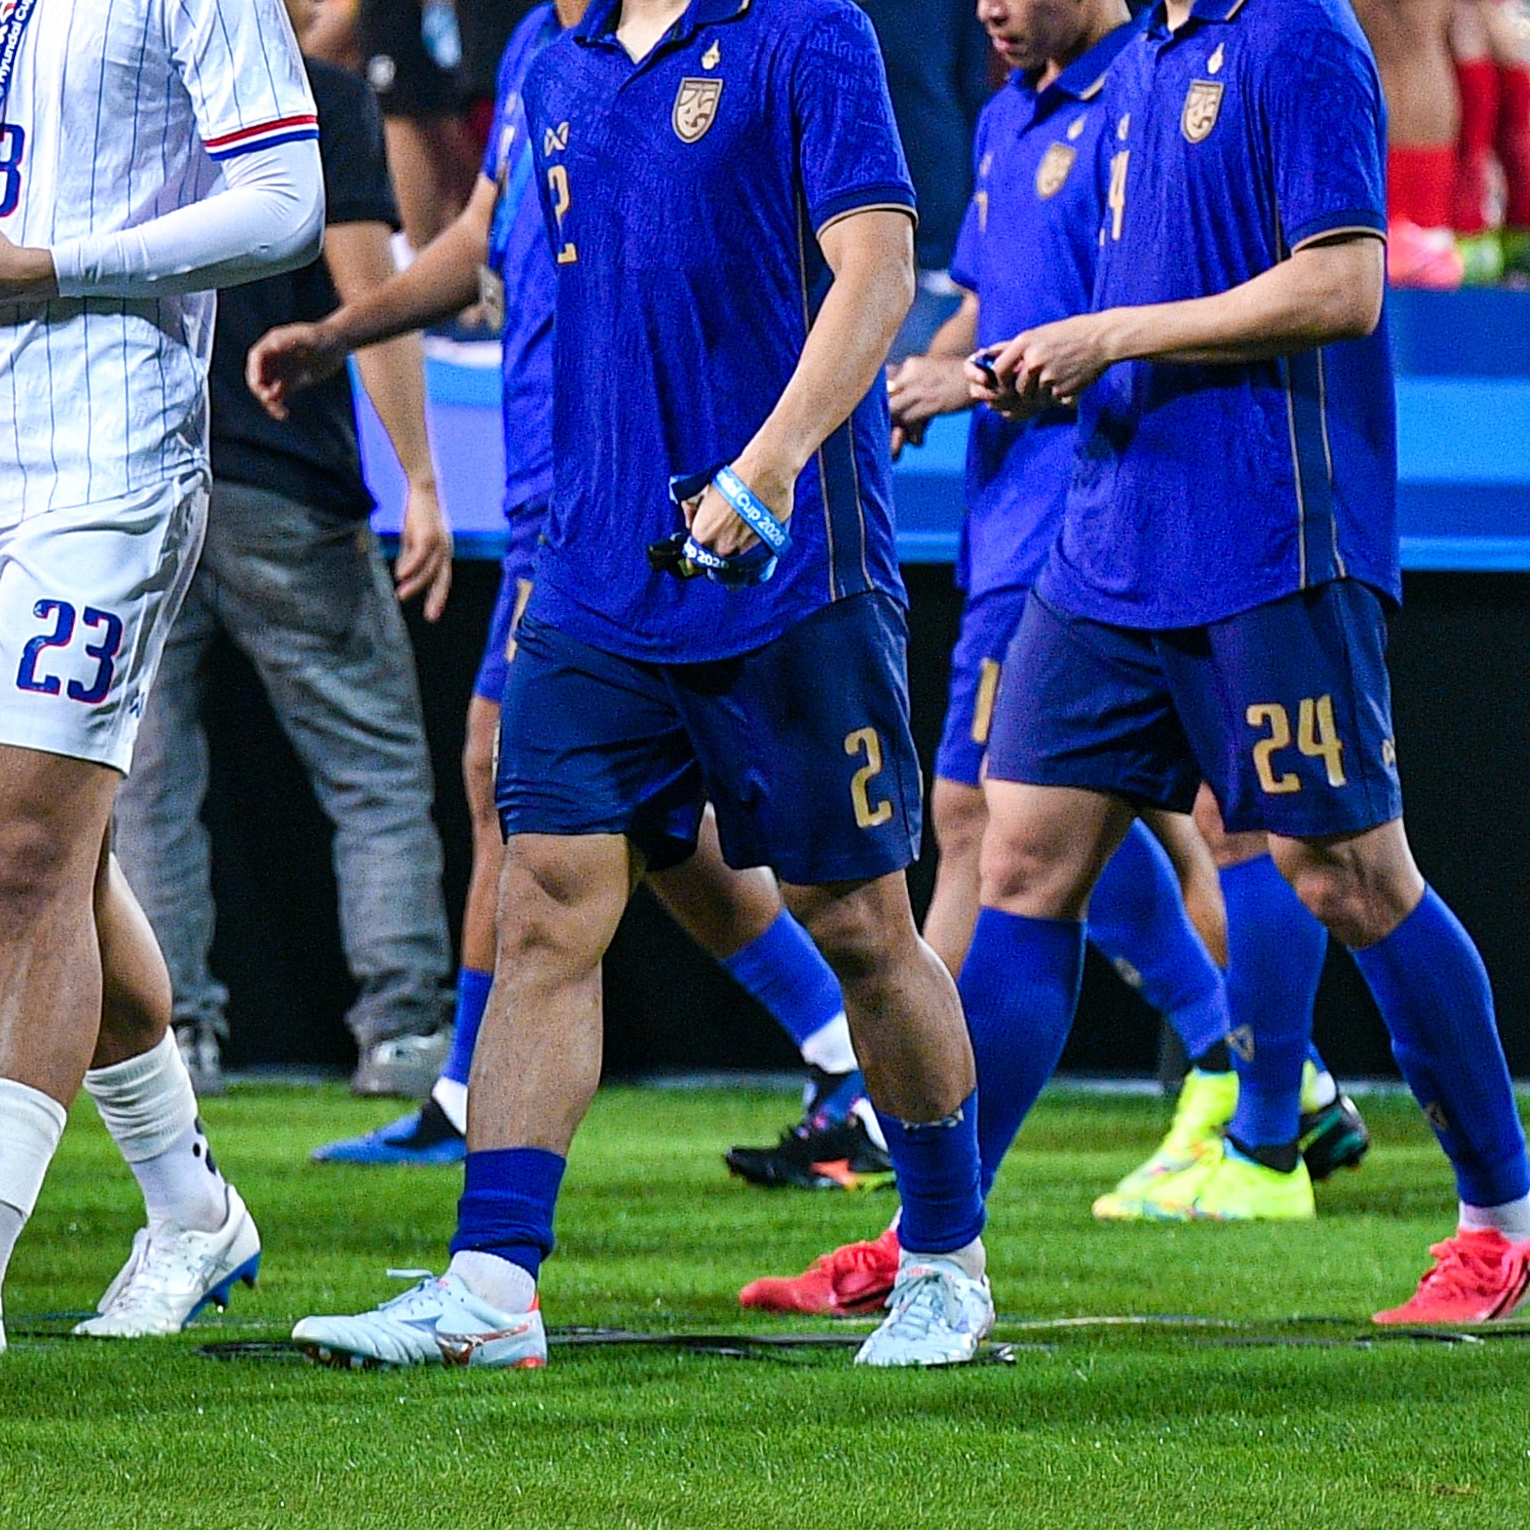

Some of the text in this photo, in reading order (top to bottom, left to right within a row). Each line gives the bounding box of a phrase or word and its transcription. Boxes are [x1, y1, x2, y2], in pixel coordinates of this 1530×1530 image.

[547, 164, 578, 263] 2
[736, 493, 786, 547] Cup 2026
[16, 598, 124, 704] 23
[844, 727, 892, 829] 2
[1246, 694, 1347, 795] 24
